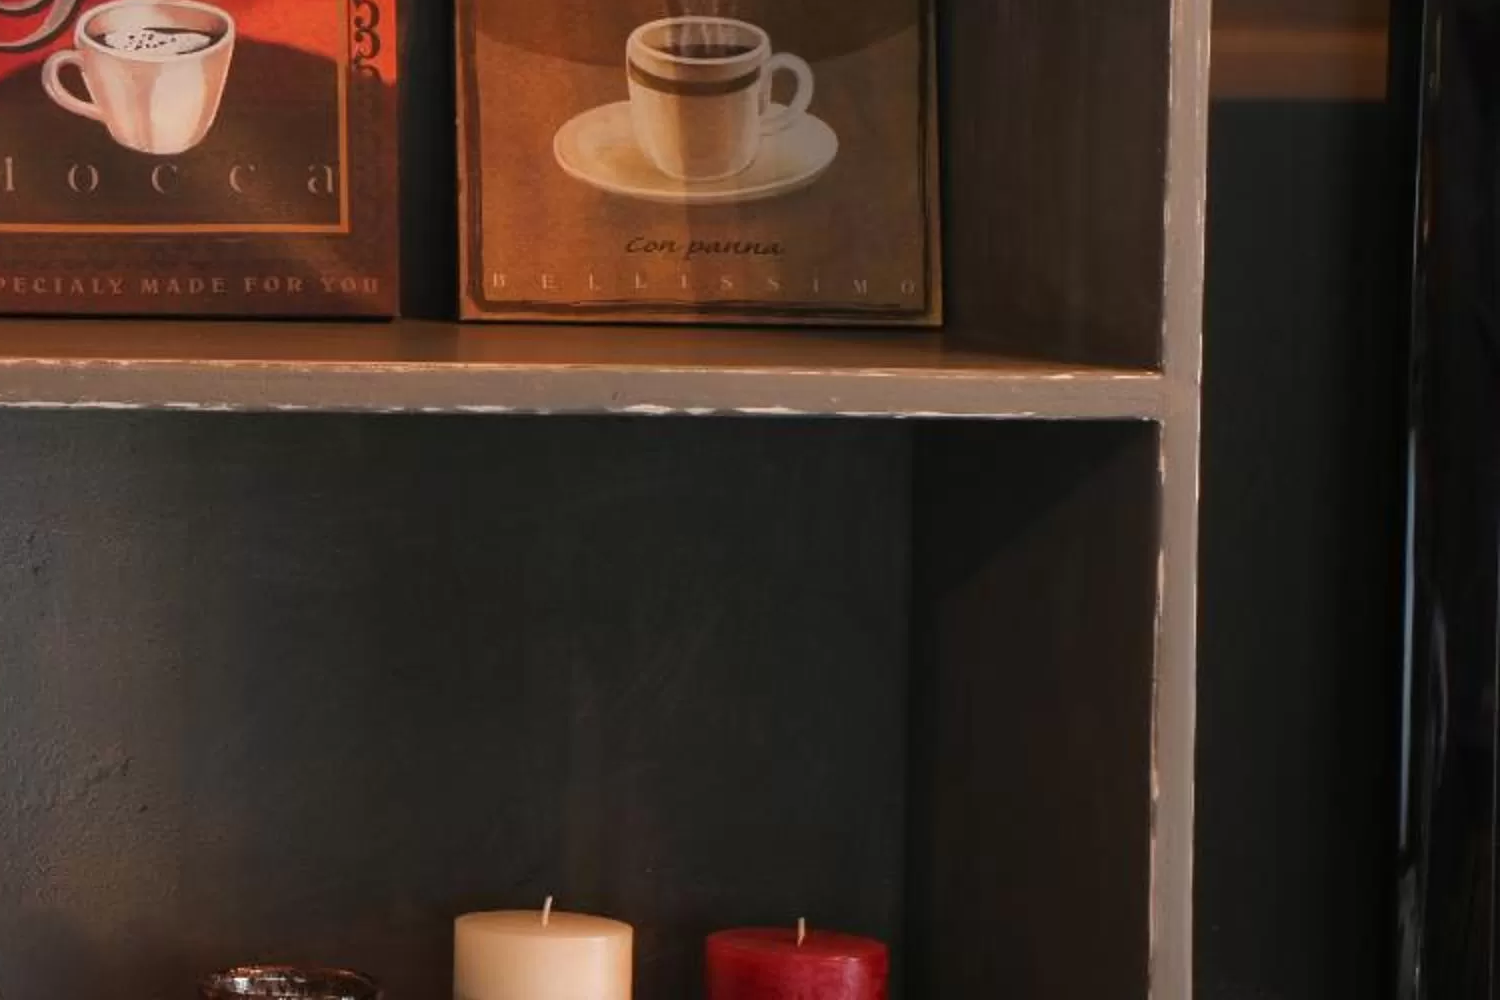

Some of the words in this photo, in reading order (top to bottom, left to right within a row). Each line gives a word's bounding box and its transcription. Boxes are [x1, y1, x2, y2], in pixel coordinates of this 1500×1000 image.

[684, 238, 784, 260] panna
[141, 277, 229, 294] MADE
[244, 276, 304, 294] FOR
[320, 276, 380, 294] YOU
[492, 271, 917, 296] BELLISSIMO
